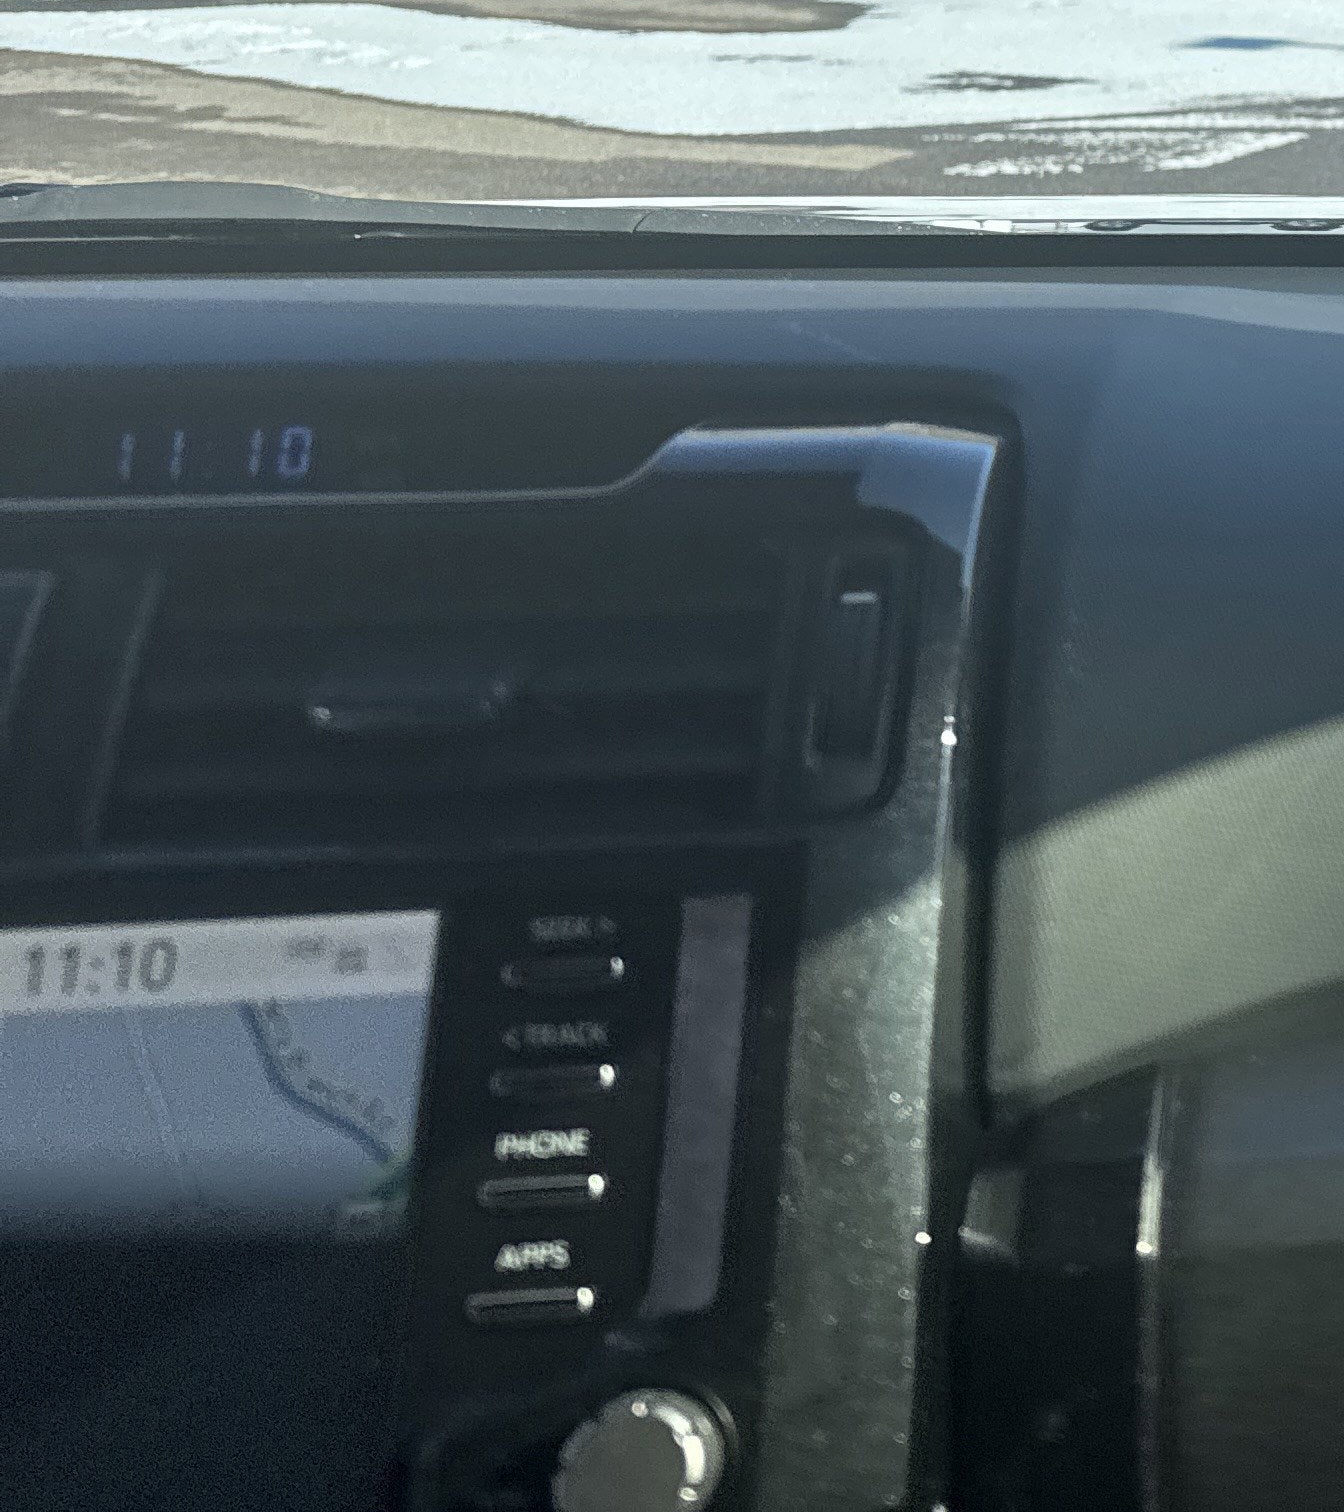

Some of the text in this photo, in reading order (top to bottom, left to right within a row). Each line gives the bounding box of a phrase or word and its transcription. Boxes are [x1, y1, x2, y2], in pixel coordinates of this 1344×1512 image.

[24, 936, 180, 997] 11:10
[494, 1128, 591, 1161] PHONE
[494, 1239, 571, 1273] APPS
